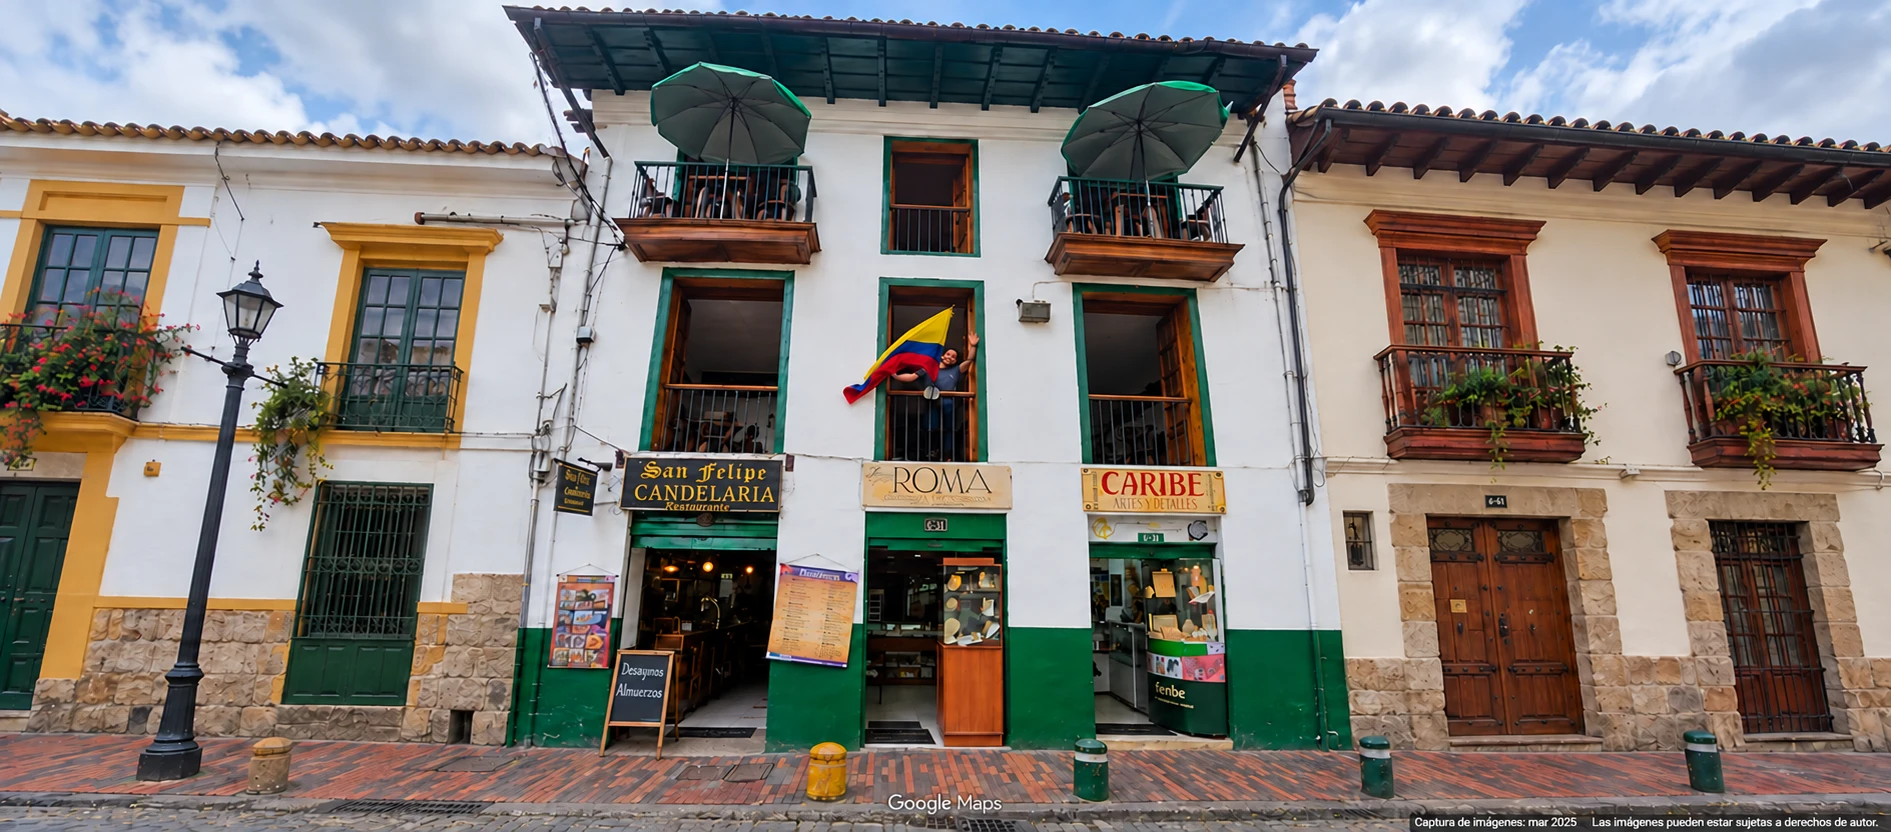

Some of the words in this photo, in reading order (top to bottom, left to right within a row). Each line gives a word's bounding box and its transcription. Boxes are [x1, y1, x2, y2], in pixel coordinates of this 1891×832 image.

[640, 460, 688, 480] San
[695, 462, 767, 484] Felipe
[893, 466, 992, 494] ROMA
[1101, 471, 1205, 497] CARIBE
[634, 484, 775, 503] CANDELARIA
[664, 501, 731, 512] Restaurante
[1113, 498, 1142, 510] ARTES
[1142, 498, 1151, 510] Y
[1153, 498, 1198, 510] DETALLES
[615, 683, 663, 699] Almuerzos
[1155, 681, 1186, 699] fenbe
